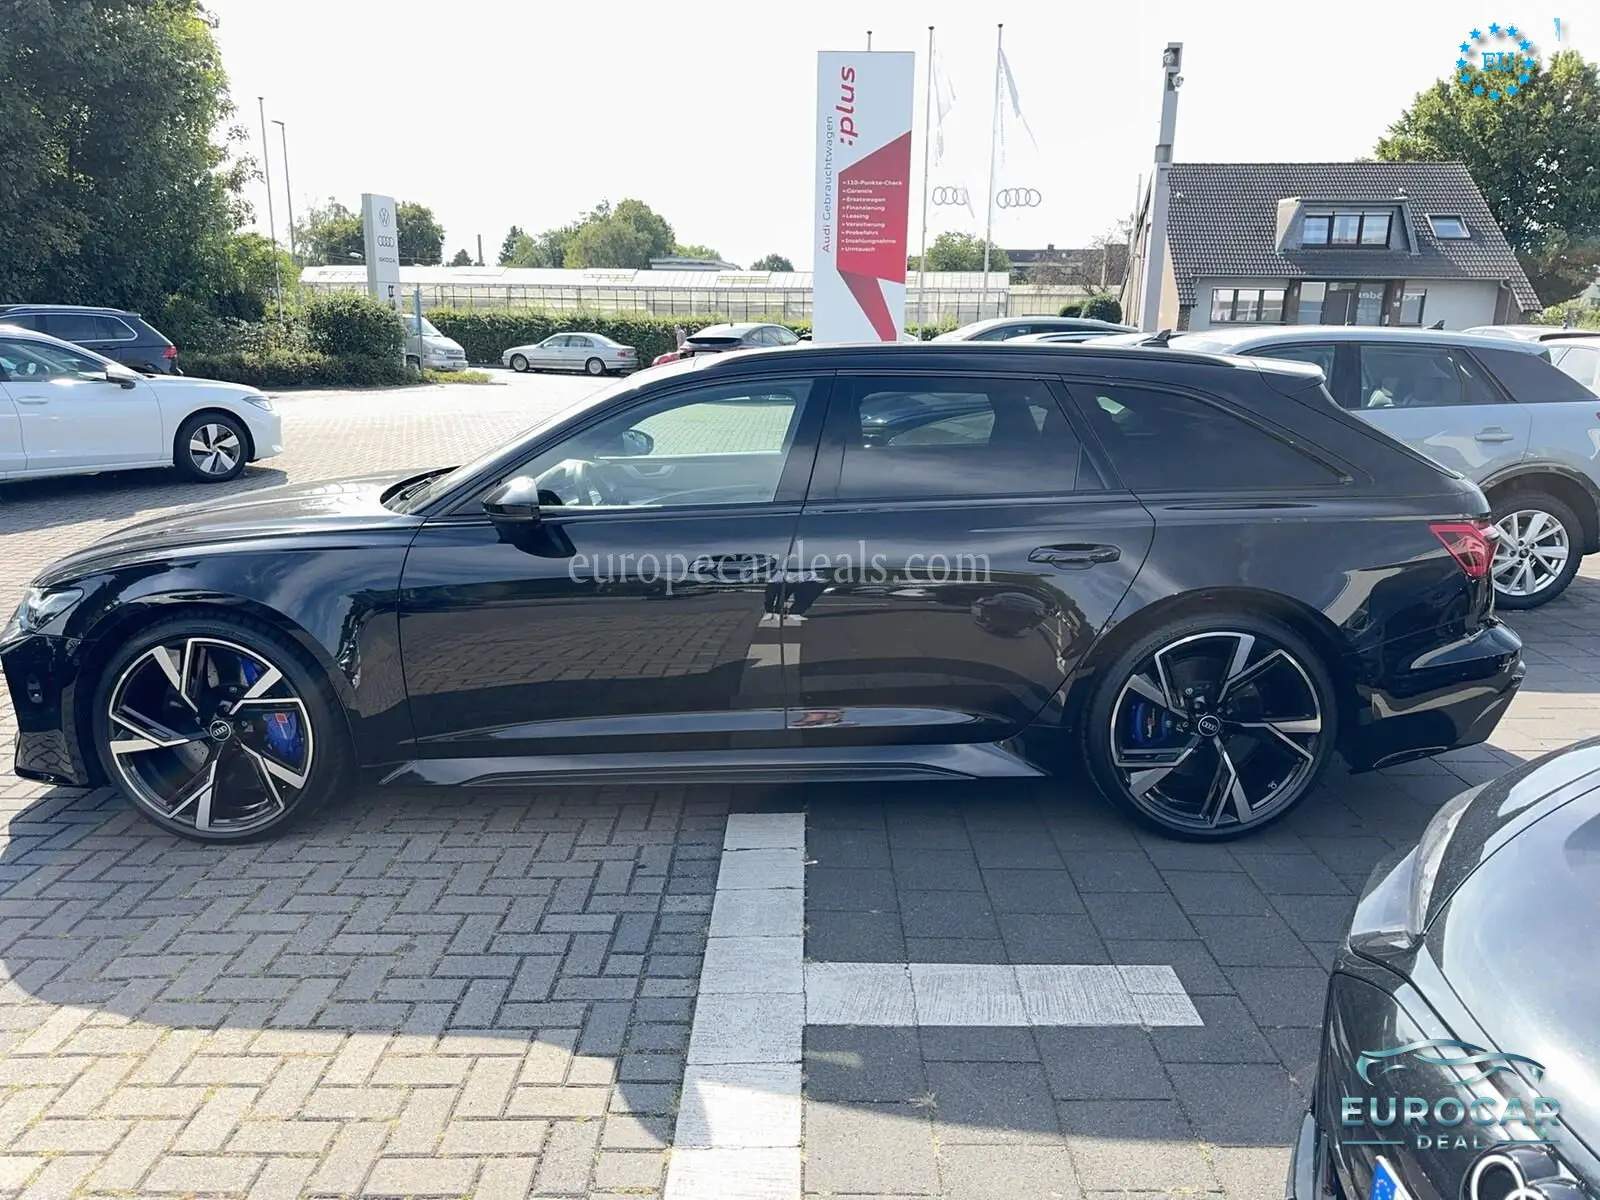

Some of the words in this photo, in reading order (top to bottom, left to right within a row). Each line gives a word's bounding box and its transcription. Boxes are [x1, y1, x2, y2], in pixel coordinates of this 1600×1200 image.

[836, 66, 859, 146] :plus
[823, 116, 835, 221] Gebrauchtwagen
[822, 224, 831, 252] Audi
